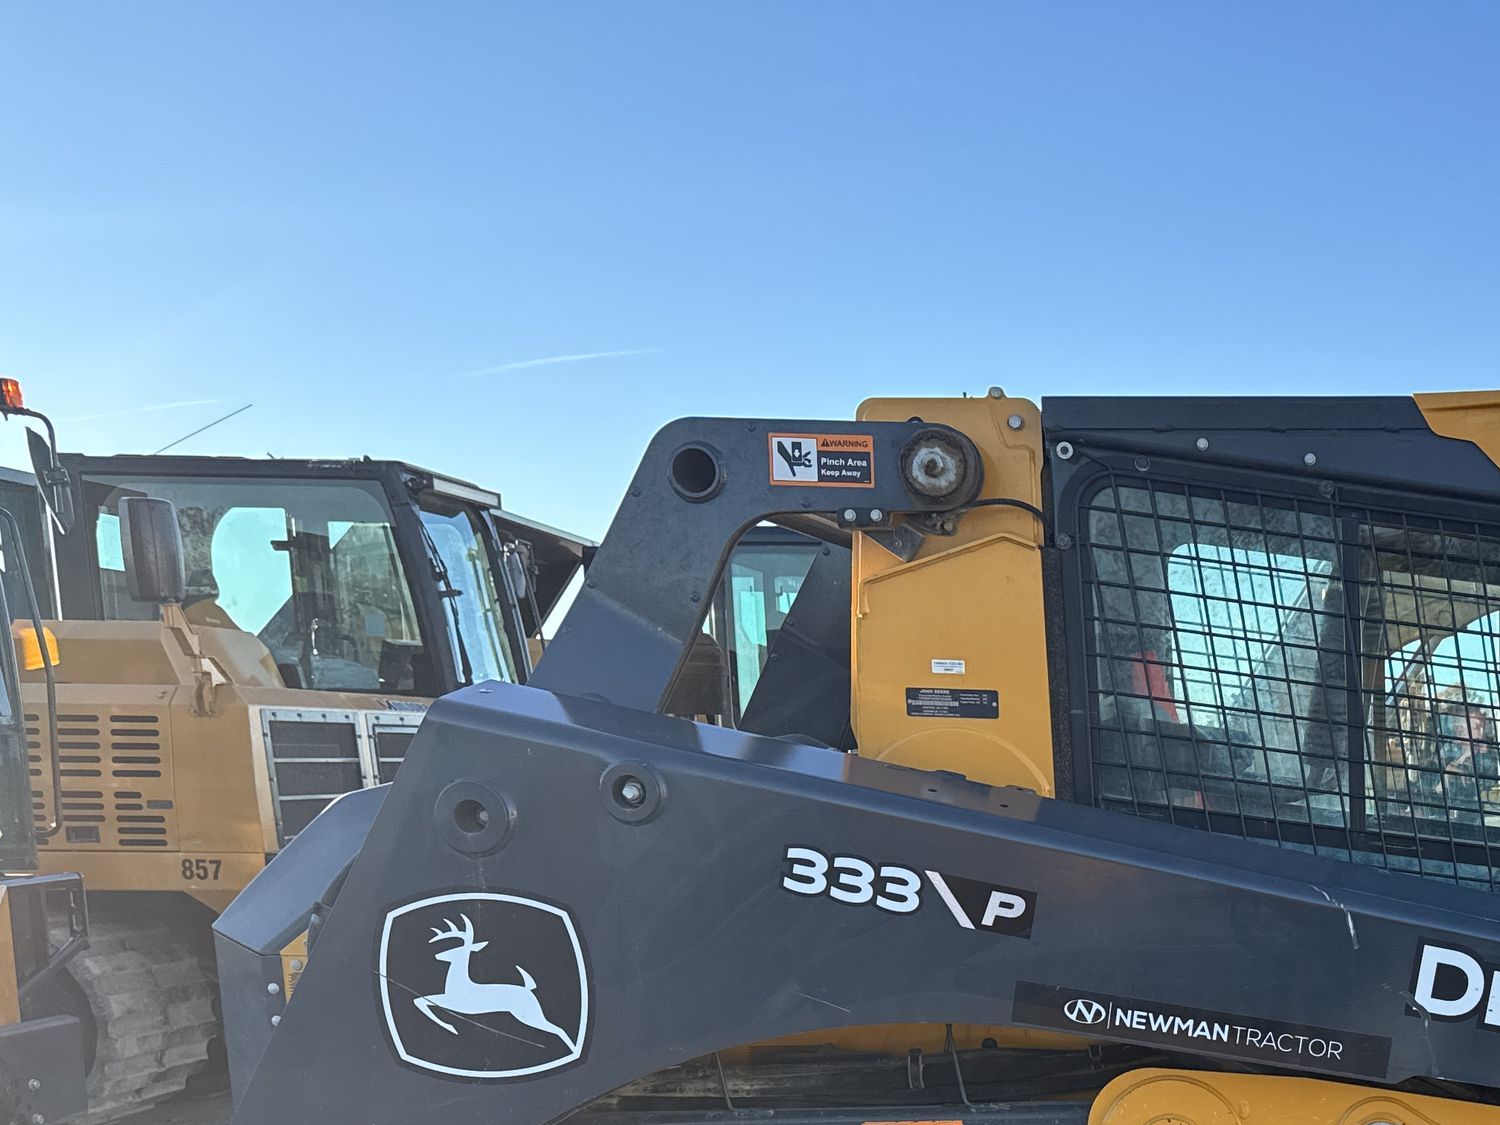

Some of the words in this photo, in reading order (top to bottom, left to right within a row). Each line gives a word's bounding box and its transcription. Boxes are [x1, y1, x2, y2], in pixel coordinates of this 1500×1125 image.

[830, 440, 868, 448] WARNING
[820, 457, 845, 466] Pinch
[847, 458, 867, 467] Area
[821, 469, 840, 478] Keep
[841, 469, 861, 478] Away
[181, 859, 222, 880] 857
